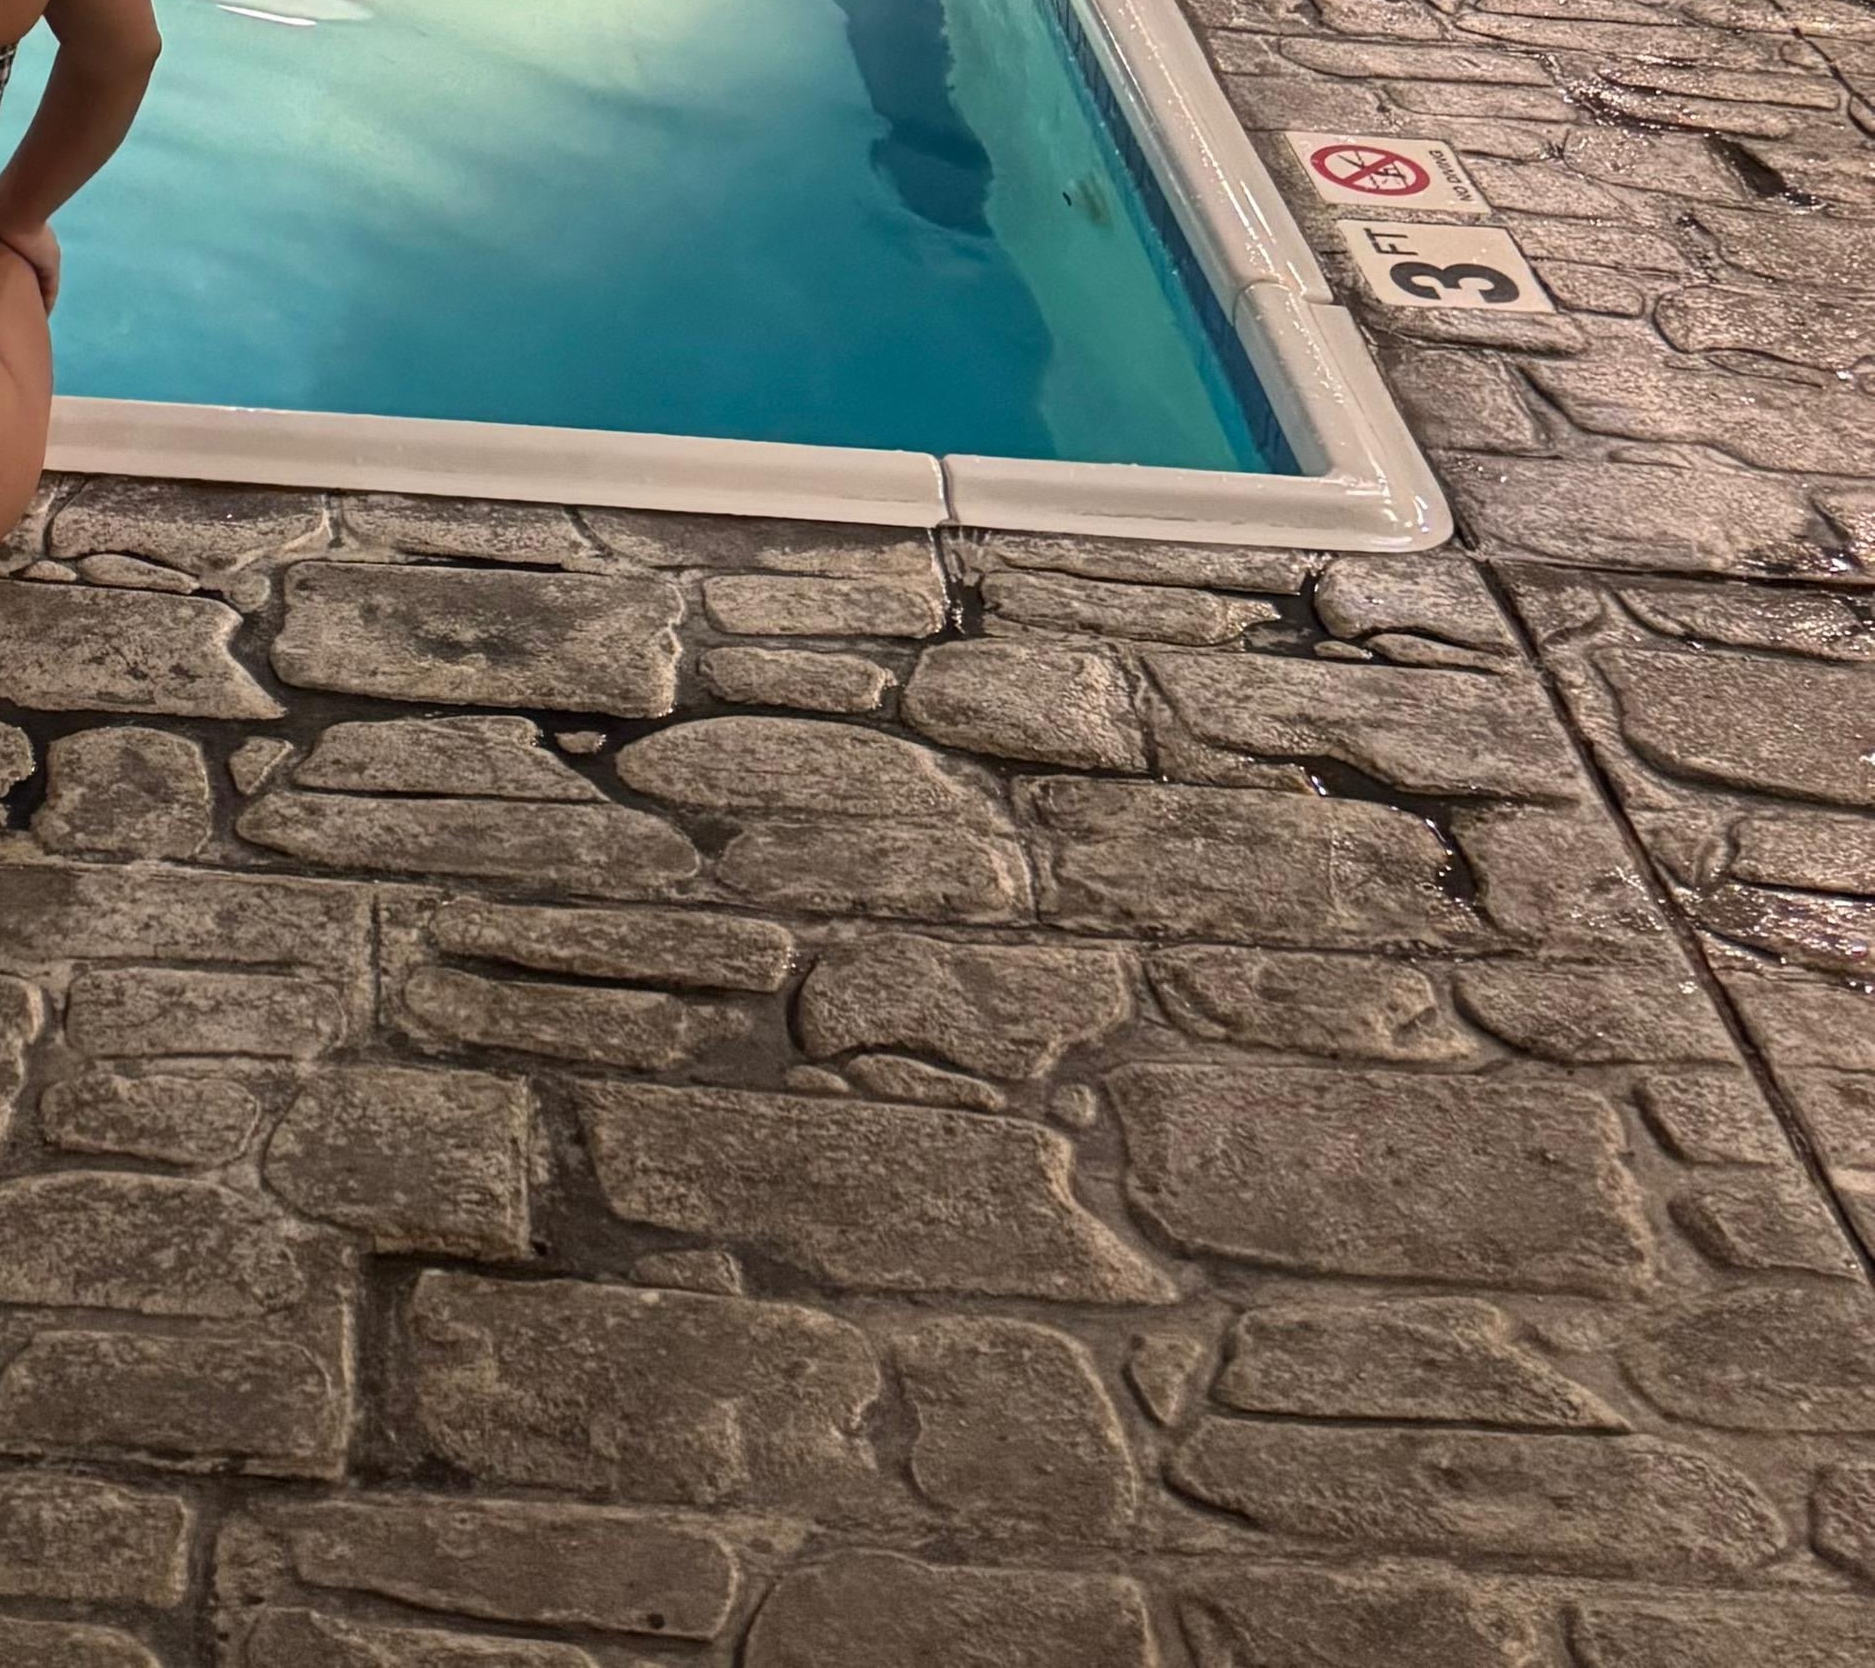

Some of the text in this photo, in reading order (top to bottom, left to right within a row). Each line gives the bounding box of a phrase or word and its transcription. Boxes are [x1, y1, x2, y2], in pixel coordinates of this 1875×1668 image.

[1428, 149, 1474, 202] NO DIVING
[1363, 227, 1520, 304] 3 FT
